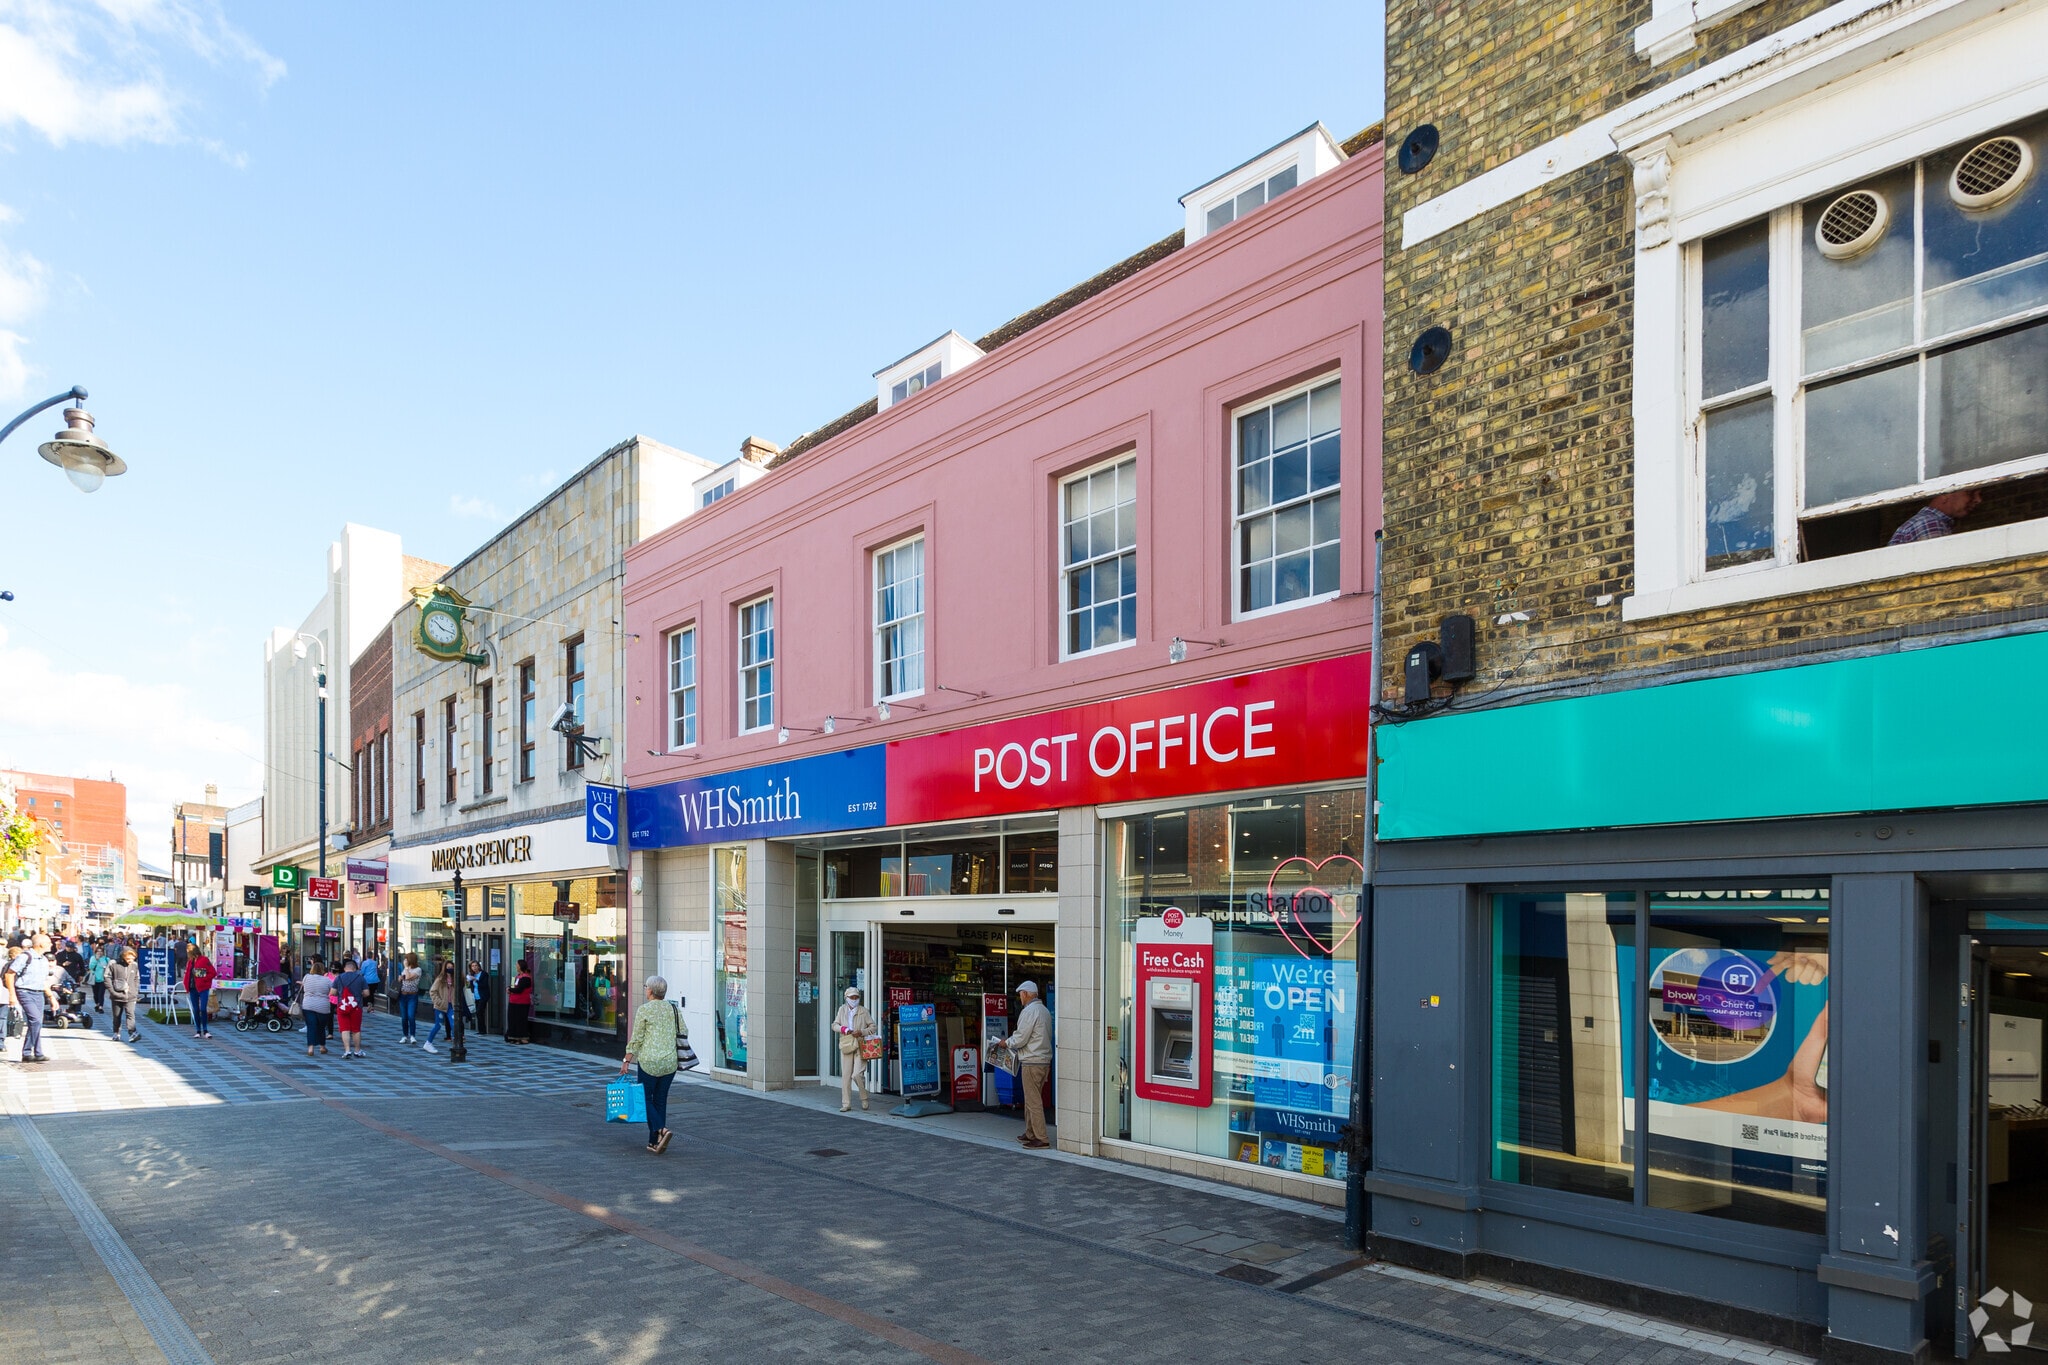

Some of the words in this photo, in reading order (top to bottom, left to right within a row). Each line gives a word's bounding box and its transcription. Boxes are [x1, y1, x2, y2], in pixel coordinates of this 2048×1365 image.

[974, 732, 1078, 793] POST
[1088, 700, 1276, 778] OFFICE
[591, 790, 612, 804] WH
[679, 776, 801, 833] WHSmith
[848, 803, 860, 813] EST
[862, 801, 877, 811] 1792
[592, 802, 614, 840] S
[431, 845, 465, 872] MARKS
[466, 844, 475, 868] &
[475, 835, 532, 867] SPENCER
[279, 869, 293, 882] D
[958, 928, 988, 941] LEASE
[1011, 933, 1035, 944] HERE
[1163, 929, 1184, 939] Money
[1143, 951, 1169, 967] Free
[1172, 951, 1204, 968] Cash
[1729, 974, 1749, 986] BT
[891, 990, 911, 1001] Half
[1263, 986, 1345, 1014] OPEN
[985, 997, 997, 1005] Only
[997, 999, 1007, 1010] £1
[1720, 1001, 1743, 1009] Chat
[1745, 1002, 1755, 1010] to
[1729, 1009, 1762, 1018] experts
[1292, 1025, 1315, 1040] 2m
[1275, 1111, 1337, 1134] WHSmith
[1312, 1150, 1324, 1158] Price
